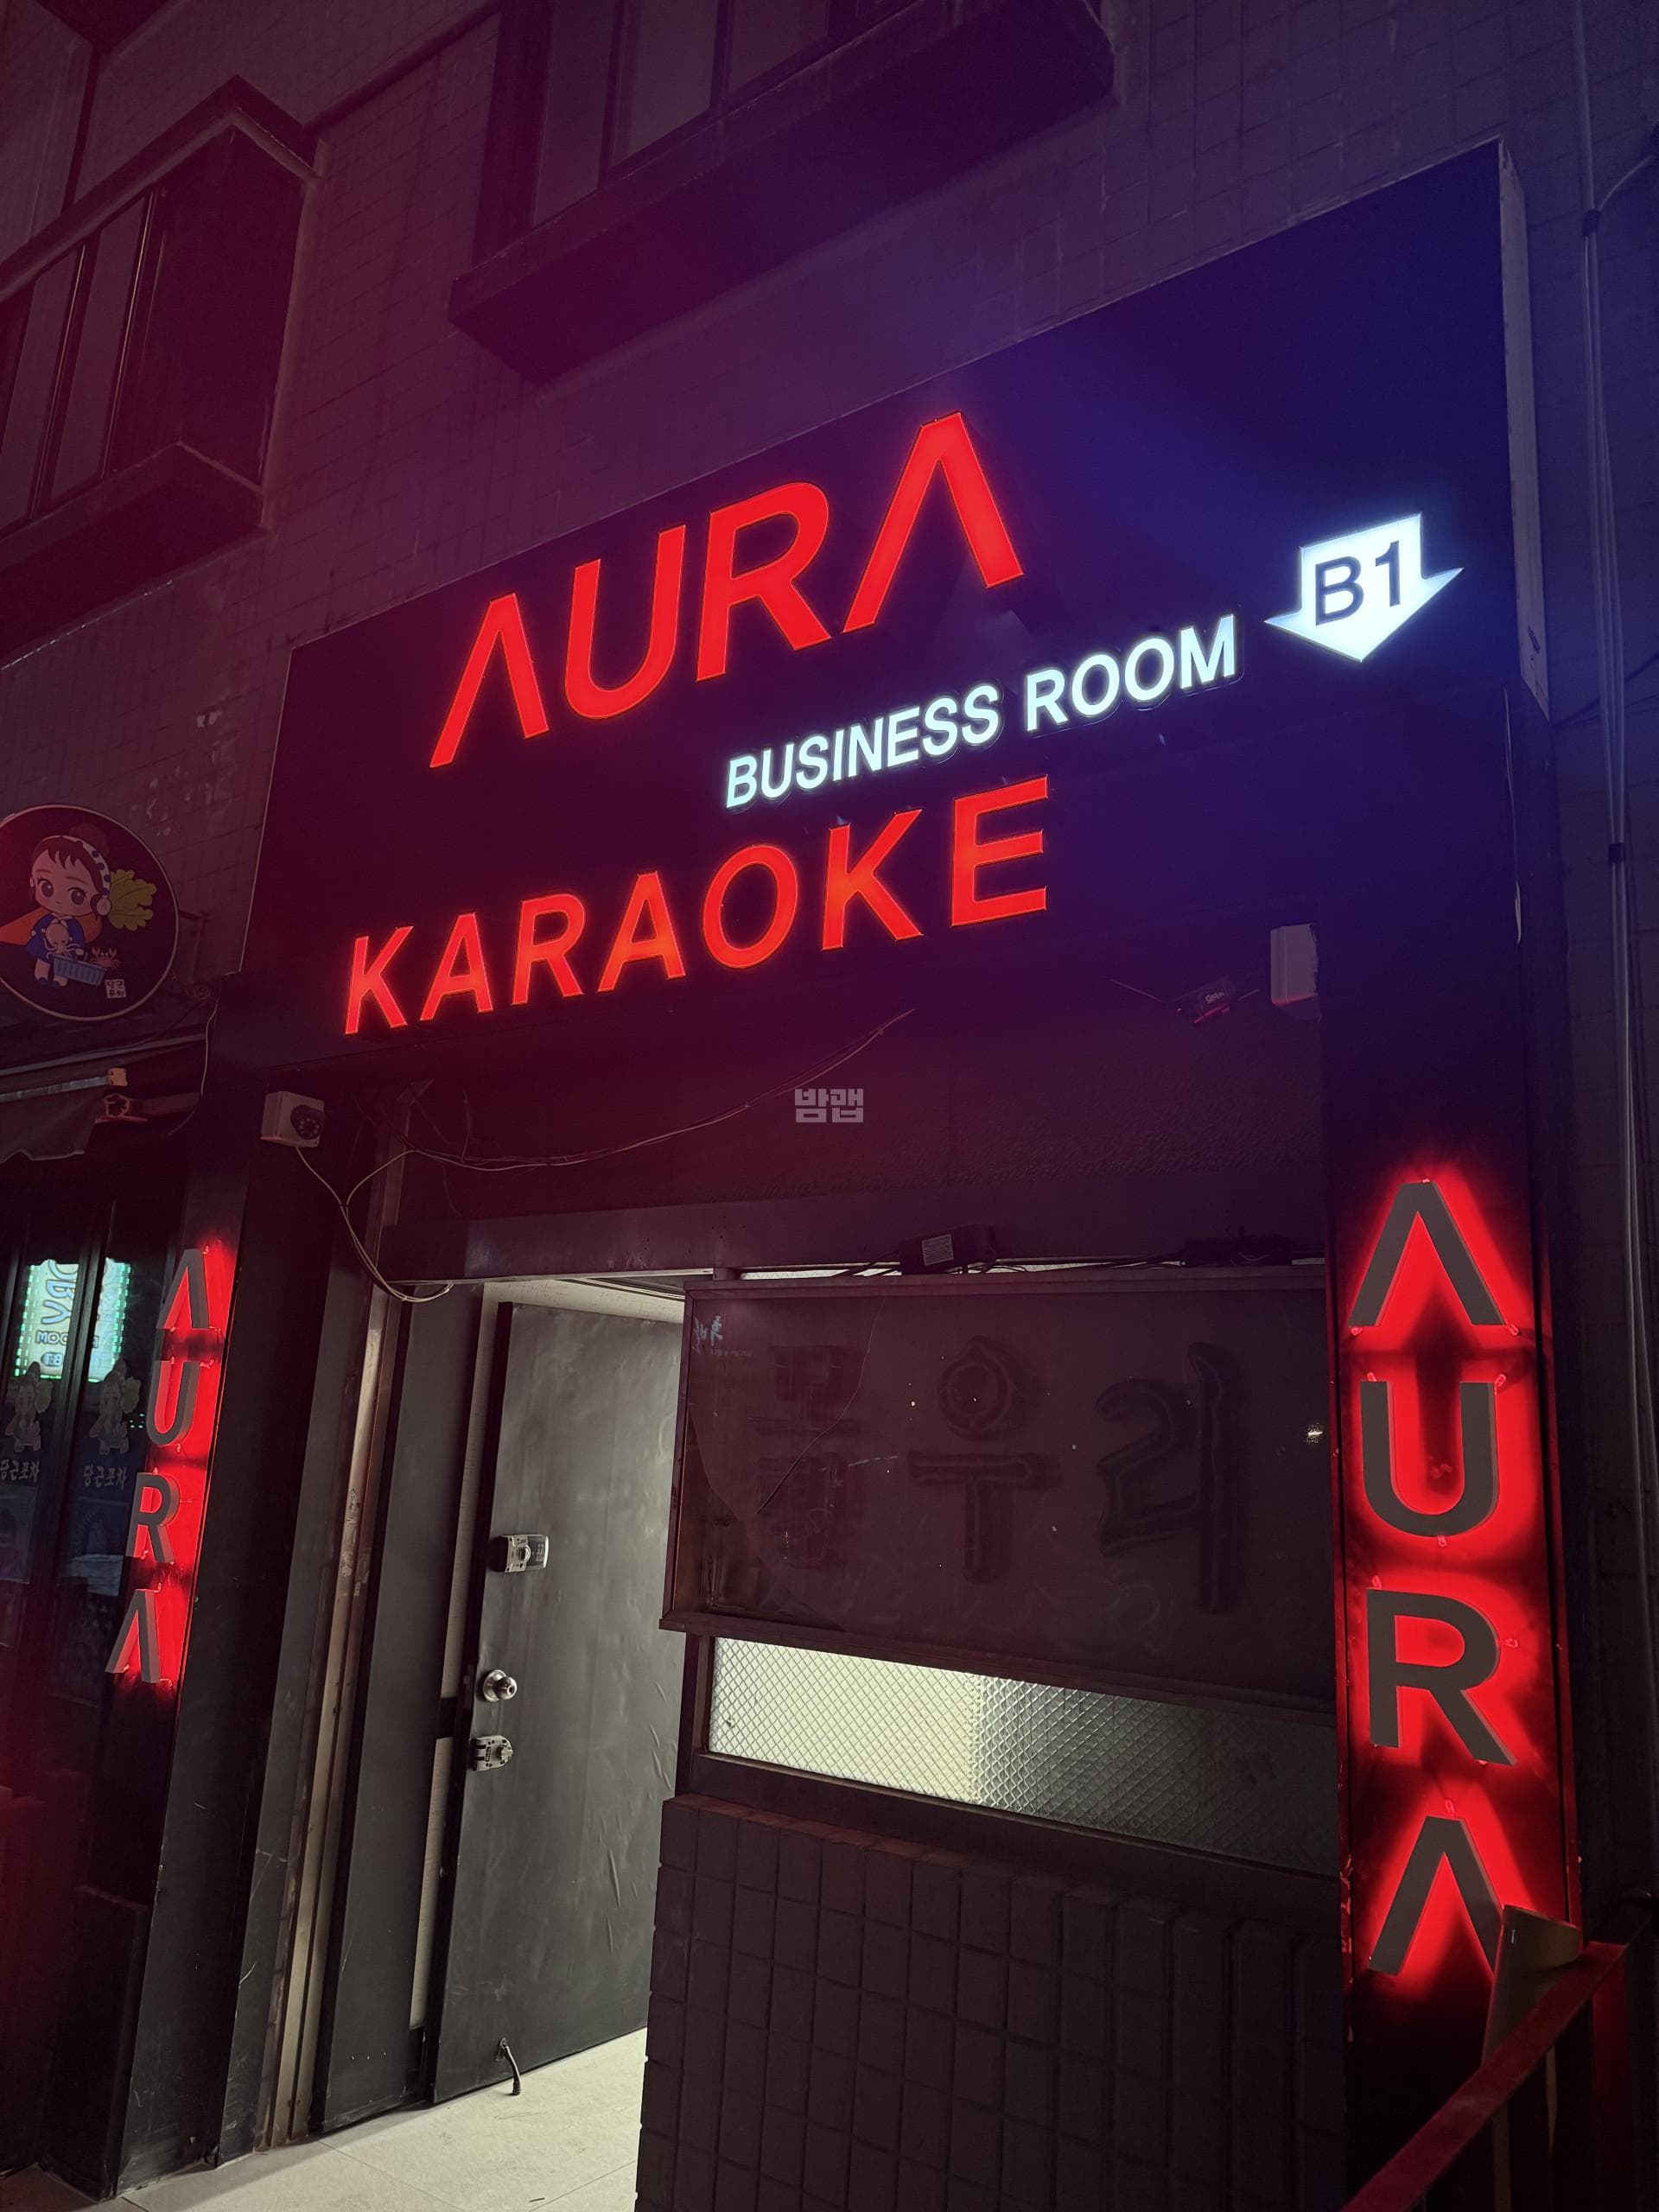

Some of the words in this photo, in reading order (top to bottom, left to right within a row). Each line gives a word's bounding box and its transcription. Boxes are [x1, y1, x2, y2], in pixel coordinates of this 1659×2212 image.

[429, 410, 1024, 767] AURA
[726, 683, 1002, 809] BUSINESS
[1026, 613, 1236, 732] ROOM
[1315, 540, 1402, 626] B1
[345, 775, 1049, 1034] KARAOKE
[105, 1248, 210, 1684] AURA
[1348, 1180, 1517, 1976] AURA
